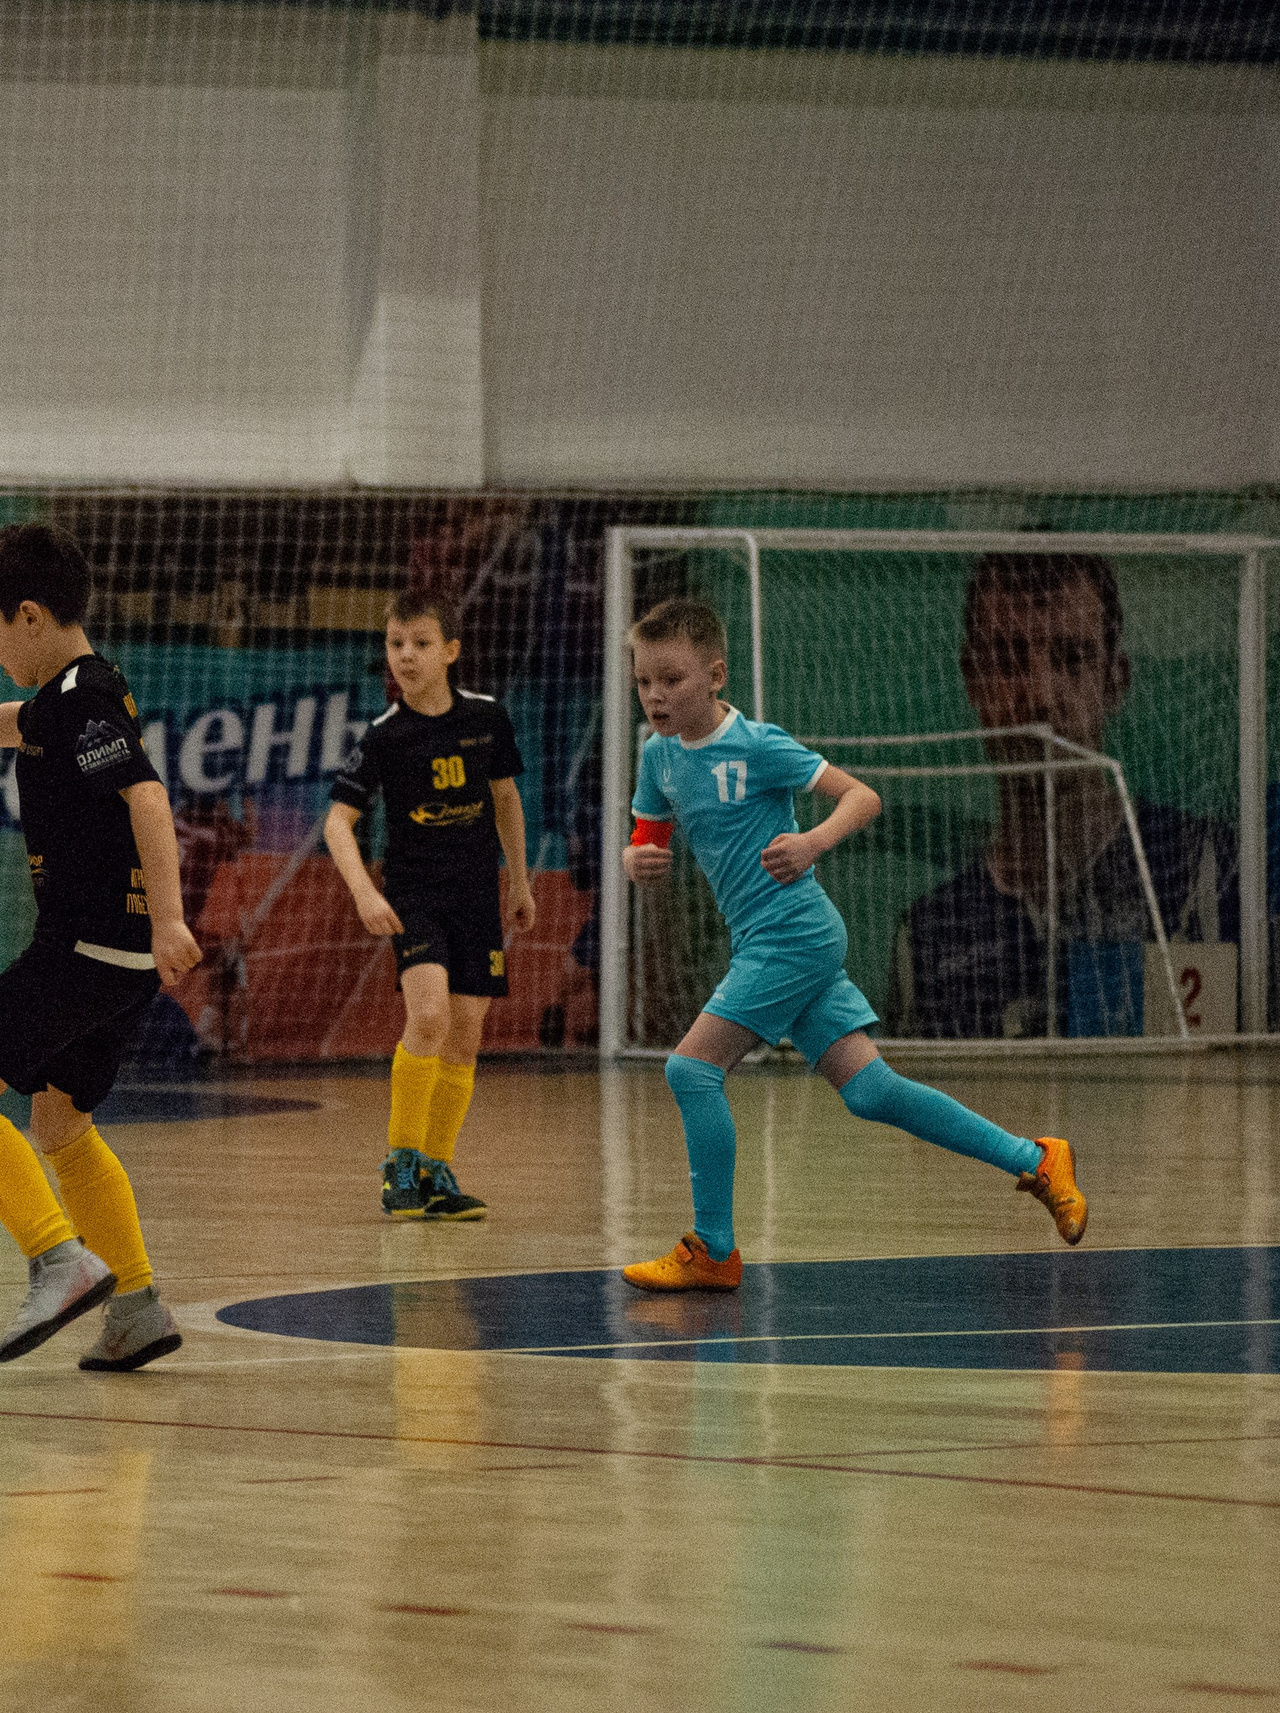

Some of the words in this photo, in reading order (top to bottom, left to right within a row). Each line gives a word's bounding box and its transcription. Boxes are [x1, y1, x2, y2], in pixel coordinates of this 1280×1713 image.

[77, 738, 128, 767] ОЛИМП
[432, 756, 467, 790] 30
[711, 760, 748, 803] 17
[1180, 968, 1202, 1027] 2
